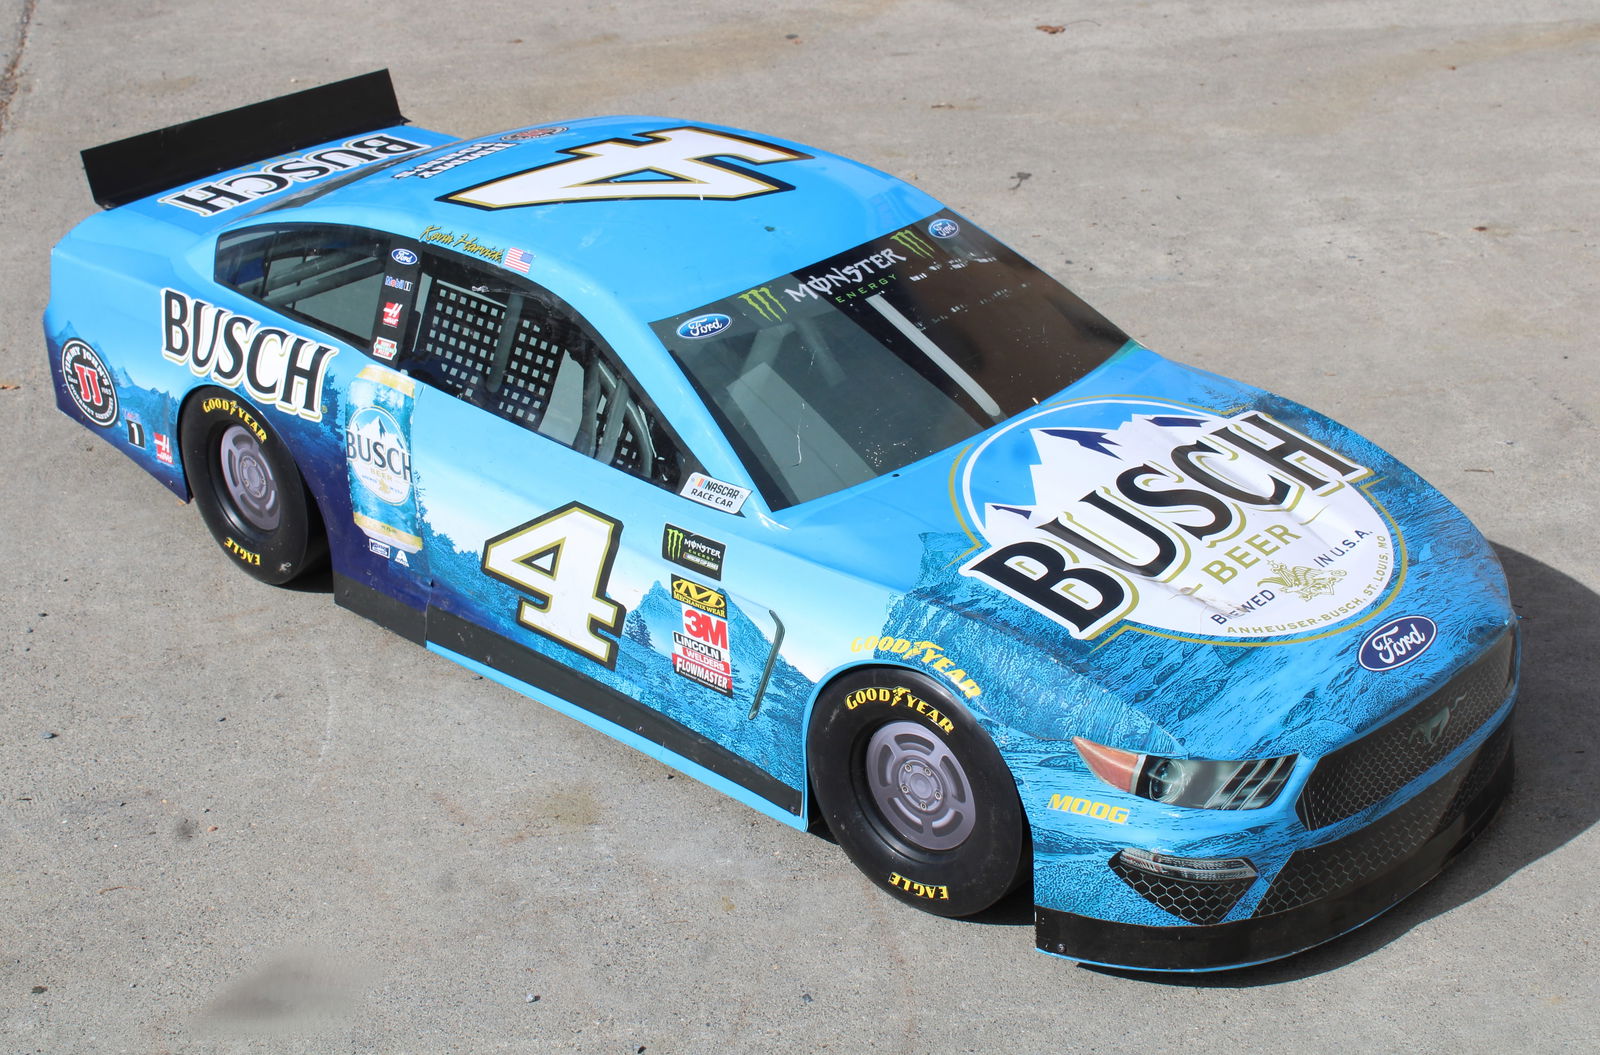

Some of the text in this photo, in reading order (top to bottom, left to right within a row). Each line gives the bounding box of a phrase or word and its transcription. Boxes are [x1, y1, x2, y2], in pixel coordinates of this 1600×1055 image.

[158, 134, 431, 217] BUSCH
[434, 126, 813, 211] 4
[419, 225, 505, 263] Kevin Harvick
[385, 275, 405, 290] Mobil
[835, 273, 897, 303] ENERGY
[688, 319, 724, 335] Ford
[161, 288, 340, 421] BUSCH
[346, 430, 413, 484] BUSCH
[691, 488, 734, 508] RACE CAR
[704, 480, 741, 500] NASCAR
[958, 412, 1366, 638] BUSCH
[224, 537, 261, 566] EAGLE
[1201, 524, 1303, 585] BEER
[1313, 553, 1334, 568] IN
[1330, 529, 1374, 557] U.S.A.
[1376, 535, 1387, 550] MO
[481, 500, 627, 672] 4
[685, 609, 728, 650] 3M
[1372, 624, 1426, 664] Ford
[675, 634, 719, 660] LINCOLN
[686, 649, 725, 672] WELDERS
[677, 656, 728, 690] FLOWMASTER
[1048, 793, 1130, 826] MOOG
[888, 871, 949, 901] EAGLE
